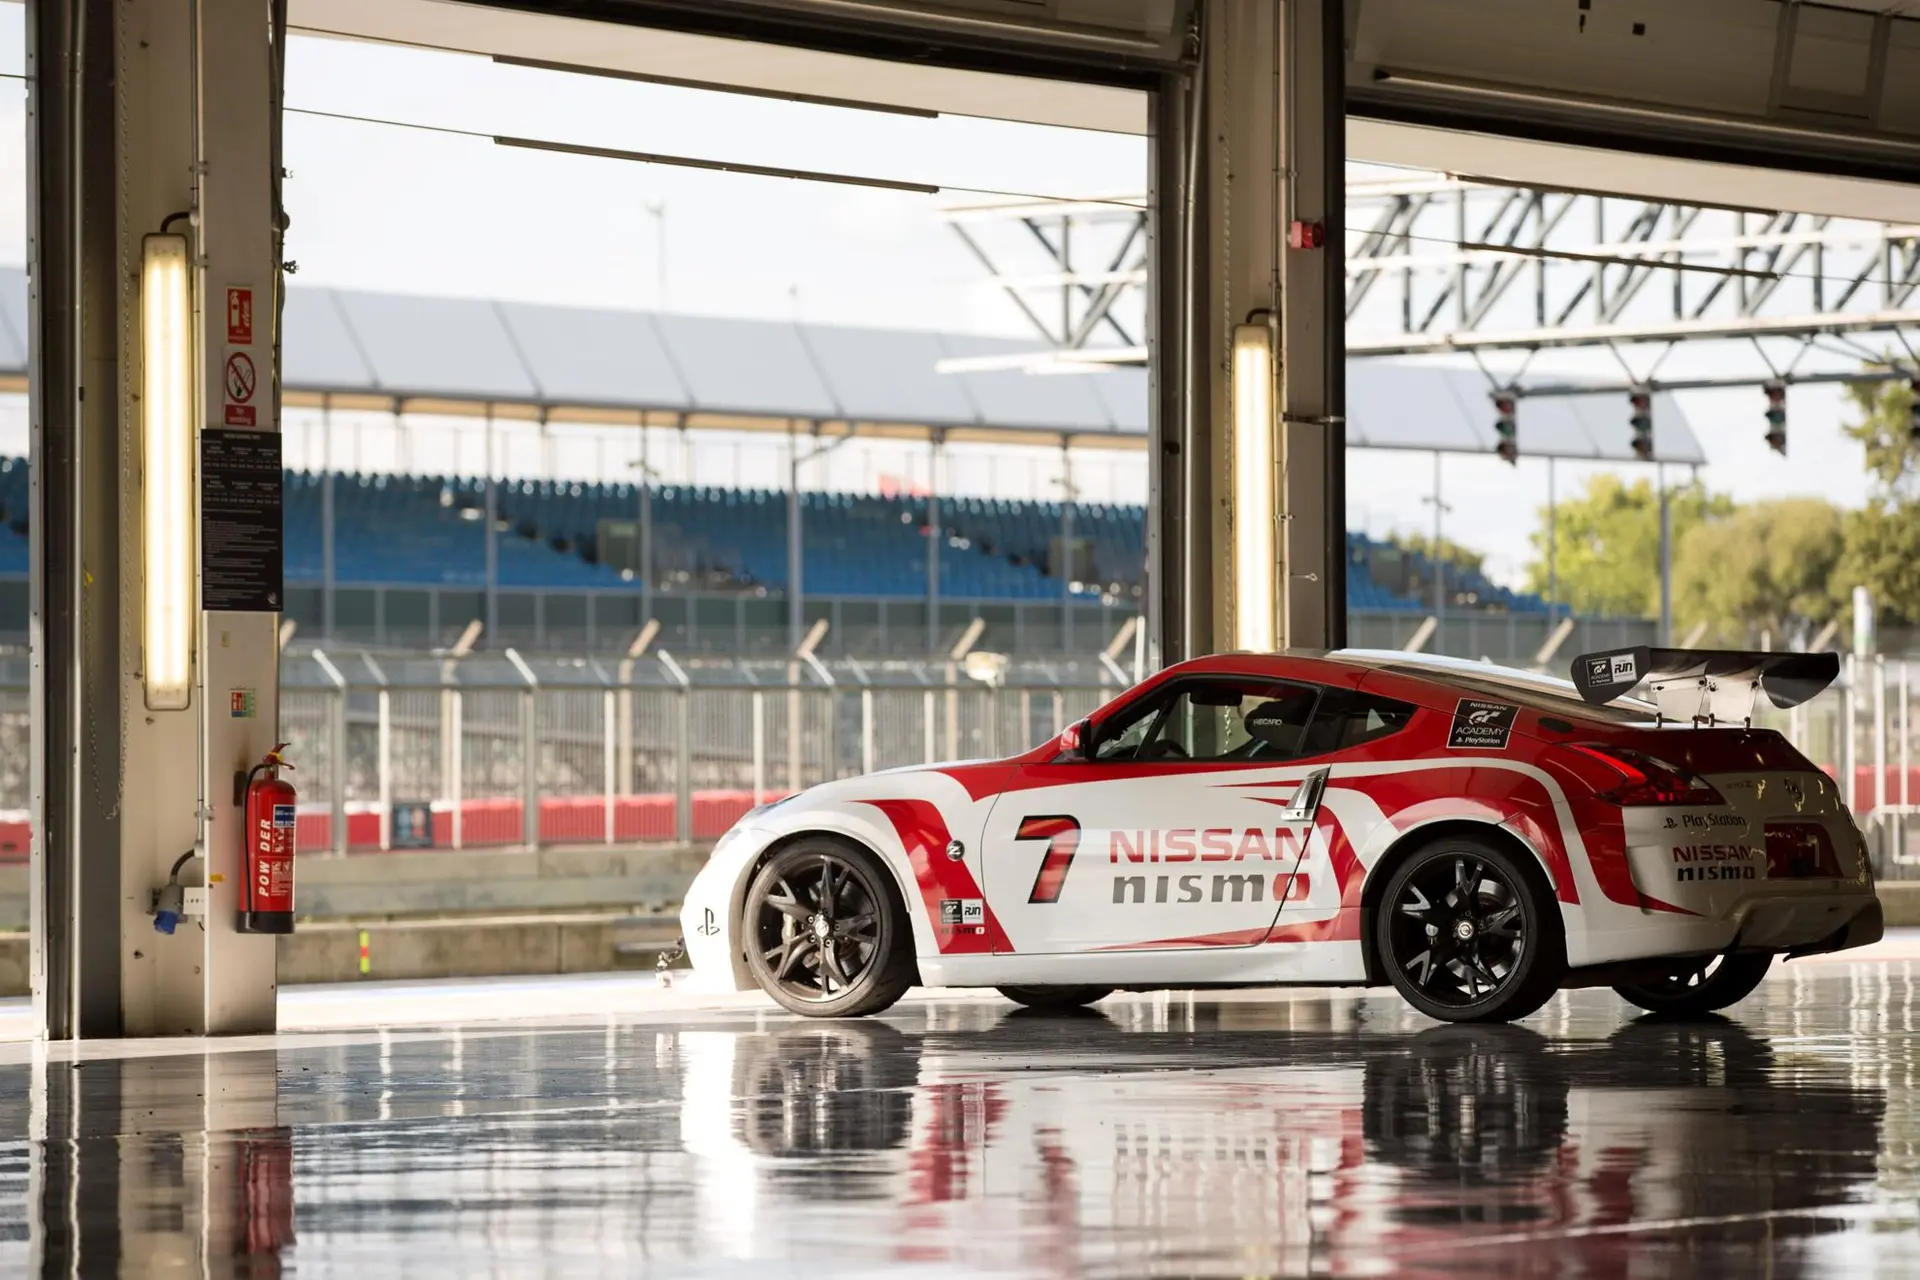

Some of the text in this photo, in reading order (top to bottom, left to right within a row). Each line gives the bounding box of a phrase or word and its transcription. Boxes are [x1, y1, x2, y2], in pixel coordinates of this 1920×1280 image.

[1470, 702, 1507, 711] NISSAN
[1254, 718, 1283, 726] RECARO
[1455, 726, 1505, 736] ACADEMY
[1682, 813, 1747, 829] PlayStation
[1110, 827, 1311, 863] NISSAN
[1673, 844, 1753, 862] NISSAN
[1014, 814, 1082, 904] 7
[1677, 866, 1755, 881] nismo
[1112, 873, 1310, 904] nismo
